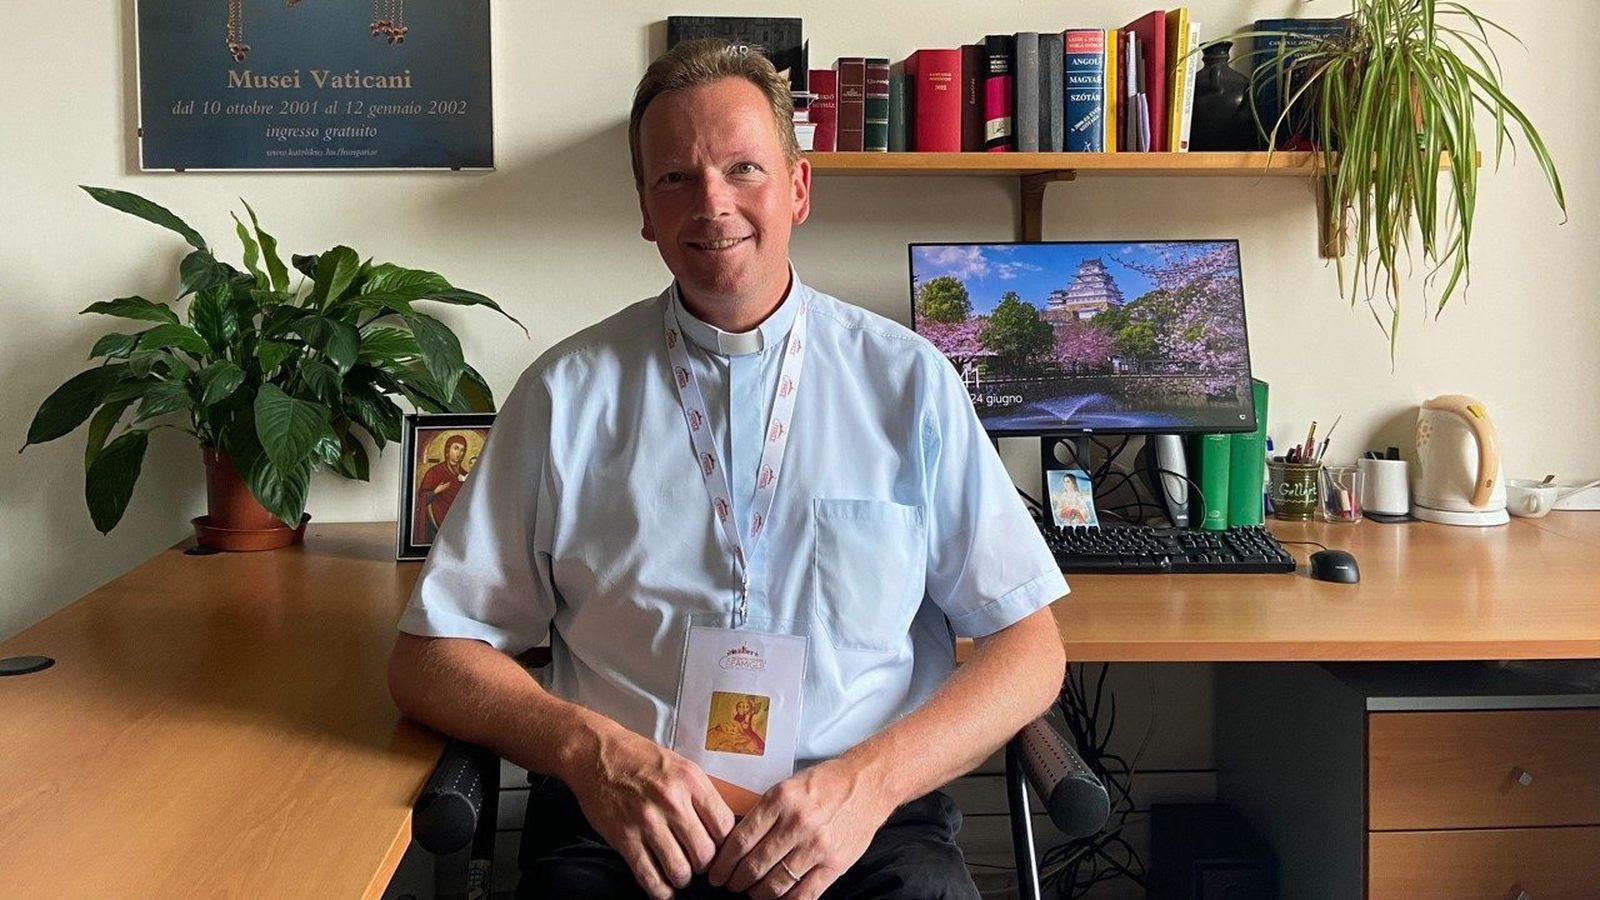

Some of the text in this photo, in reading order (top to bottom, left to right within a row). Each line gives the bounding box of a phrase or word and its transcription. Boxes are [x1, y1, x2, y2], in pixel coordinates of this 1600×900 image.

[227, 69, 413, 89] Musei Vaticani
[1070, 92, 1101, 101] SZÓTÁR
[172, 100, 468, 118] dal 10 ottobre 2001 al 12 gennaio 2002
[266, 124, 377, 141] ingresso gratuito
[970, 393, 1023, 407] 24 giugno
